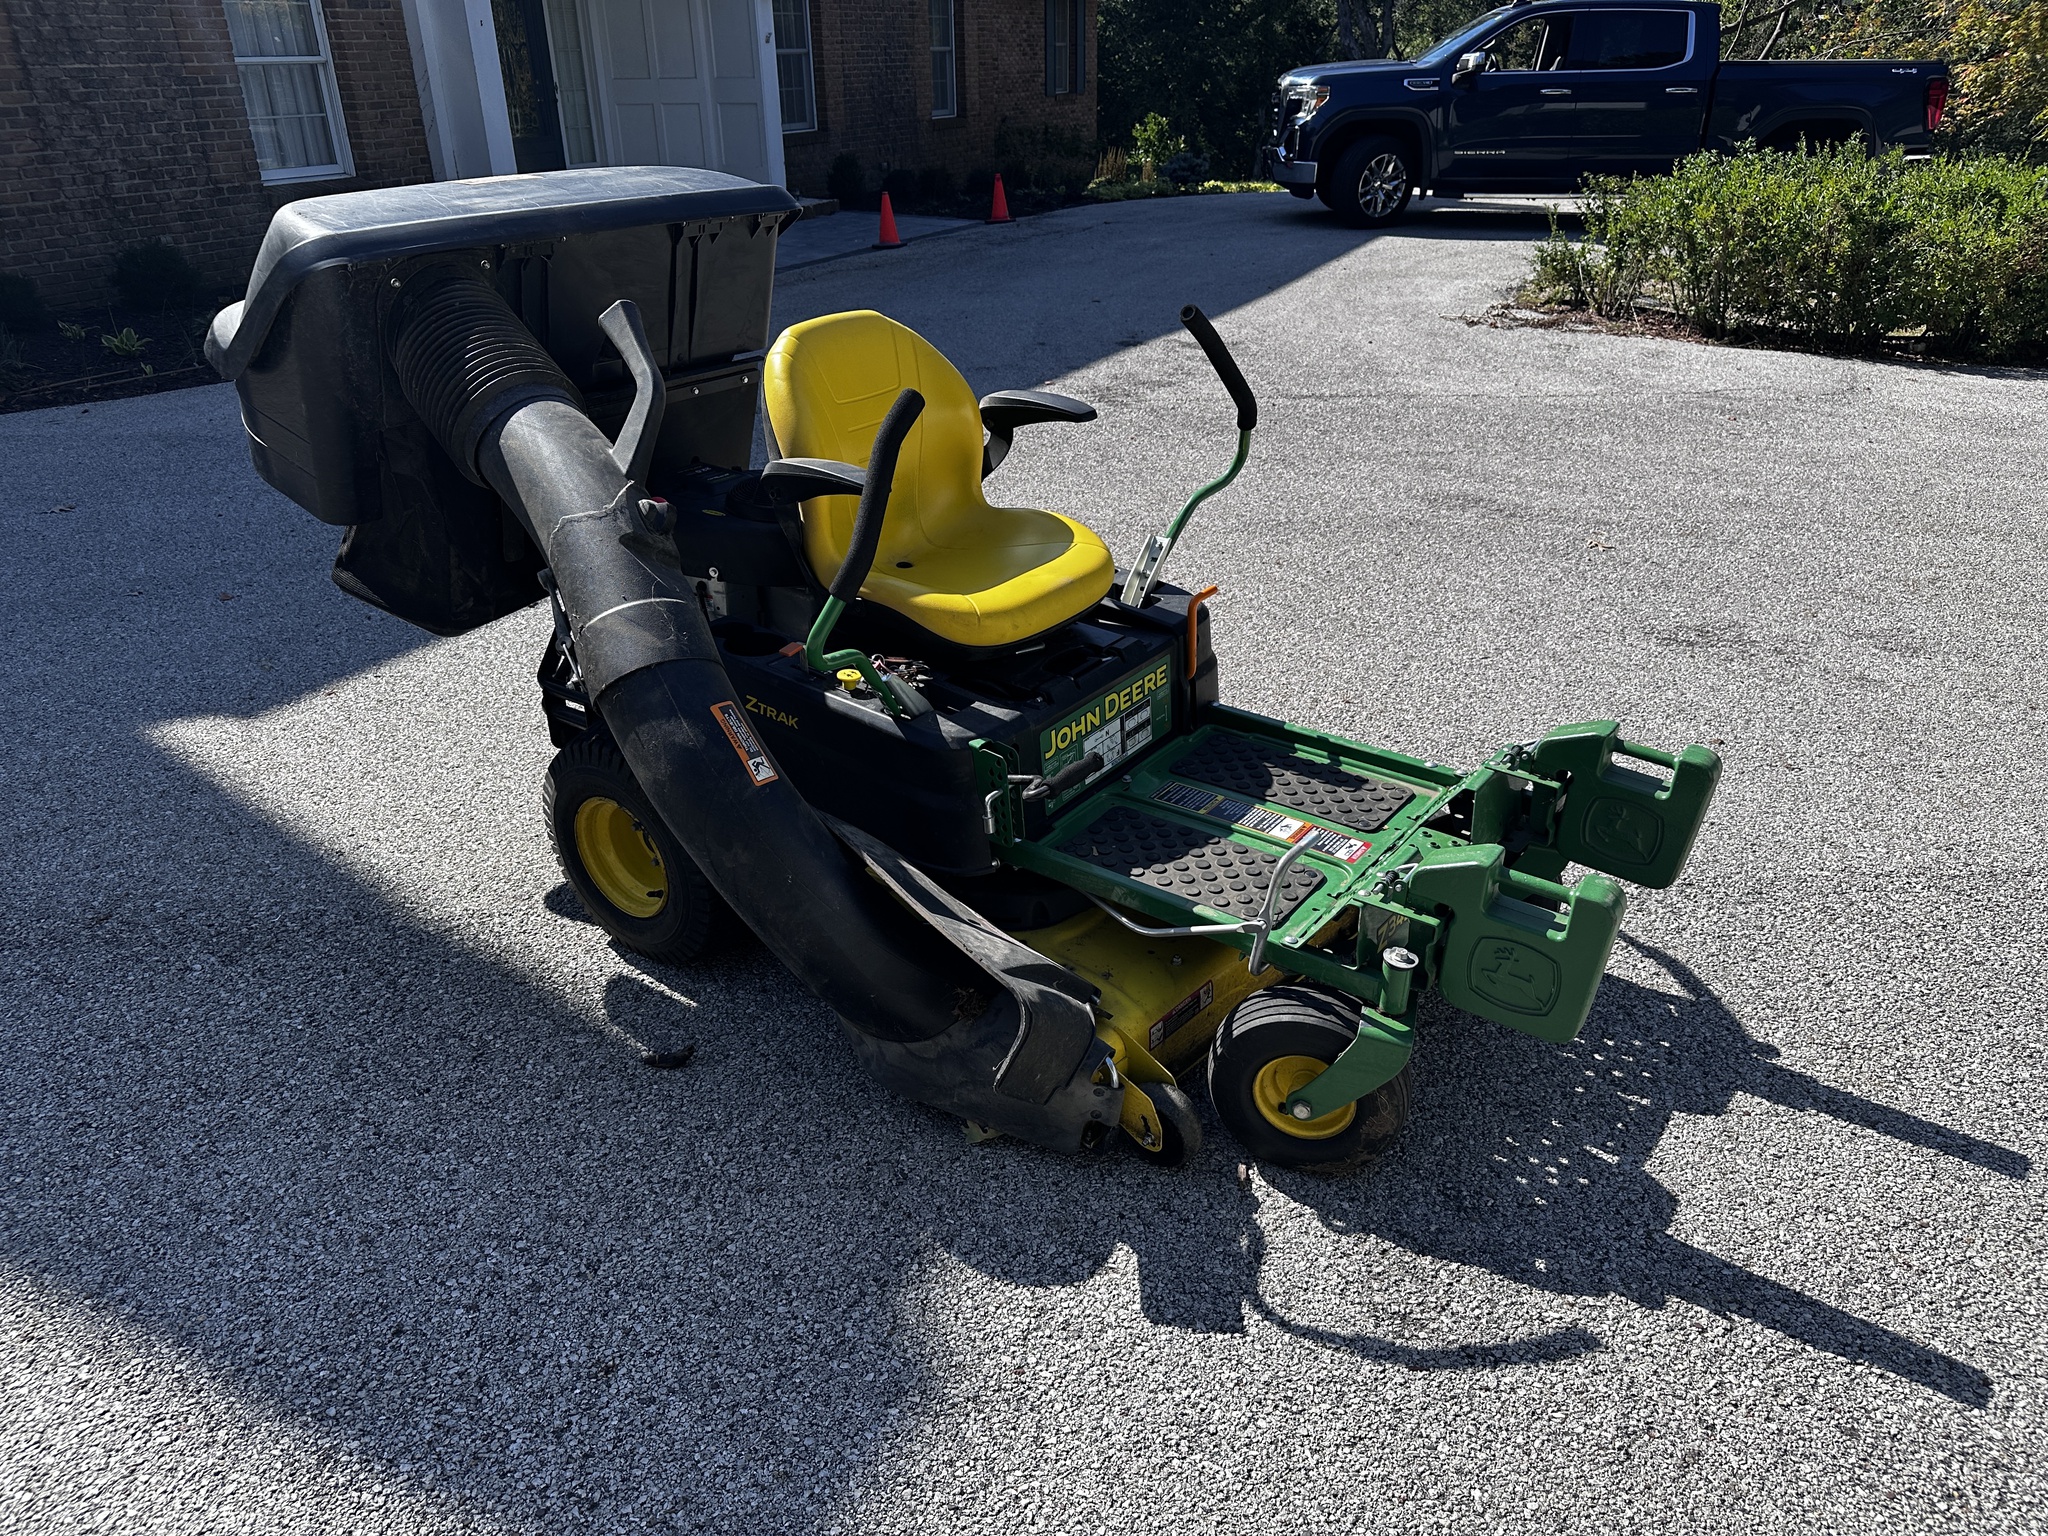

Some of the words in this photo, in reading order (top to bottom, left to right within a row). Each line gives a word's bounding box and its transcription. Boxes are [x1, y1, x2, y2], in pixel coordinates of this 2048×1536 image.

[745, 694, 799, 730] ZTRAK
[1045, 706, 1100, 760] JOHN
[1104, 664, 1167, 720] DEERE
